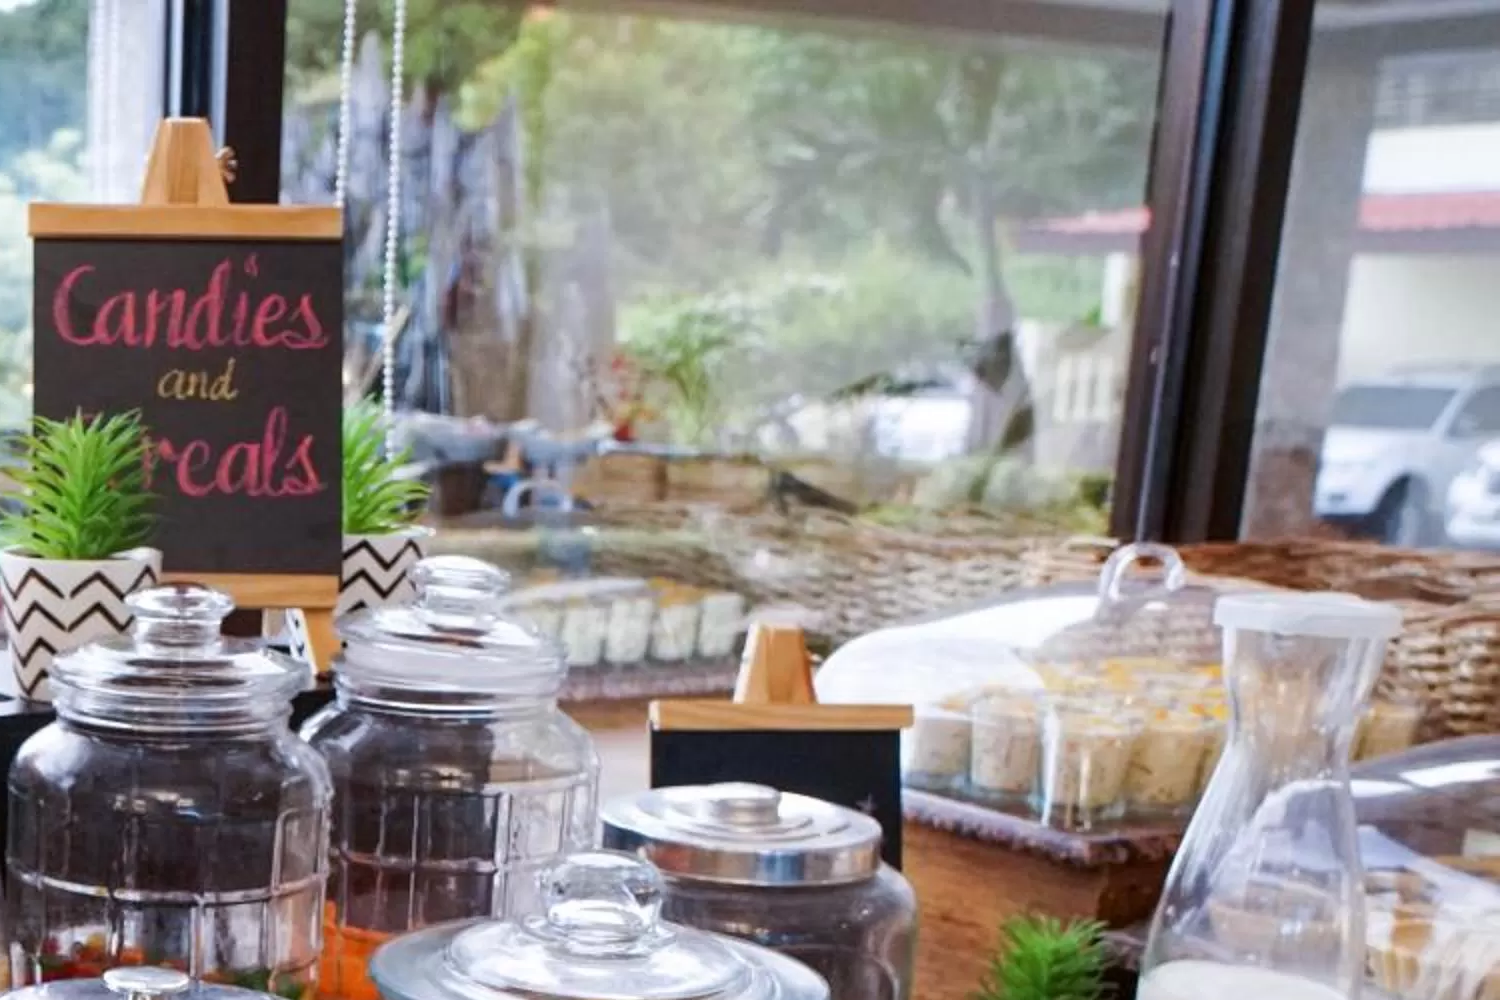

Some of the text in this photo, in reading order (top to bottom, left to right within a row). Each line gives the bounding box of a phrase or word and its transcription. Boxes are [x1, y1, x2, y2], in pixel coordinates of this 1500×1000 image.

[52, 252, 329, 350] Candies
[157, 356, 239, 401] and
[70, 407, 327, 497] reals
